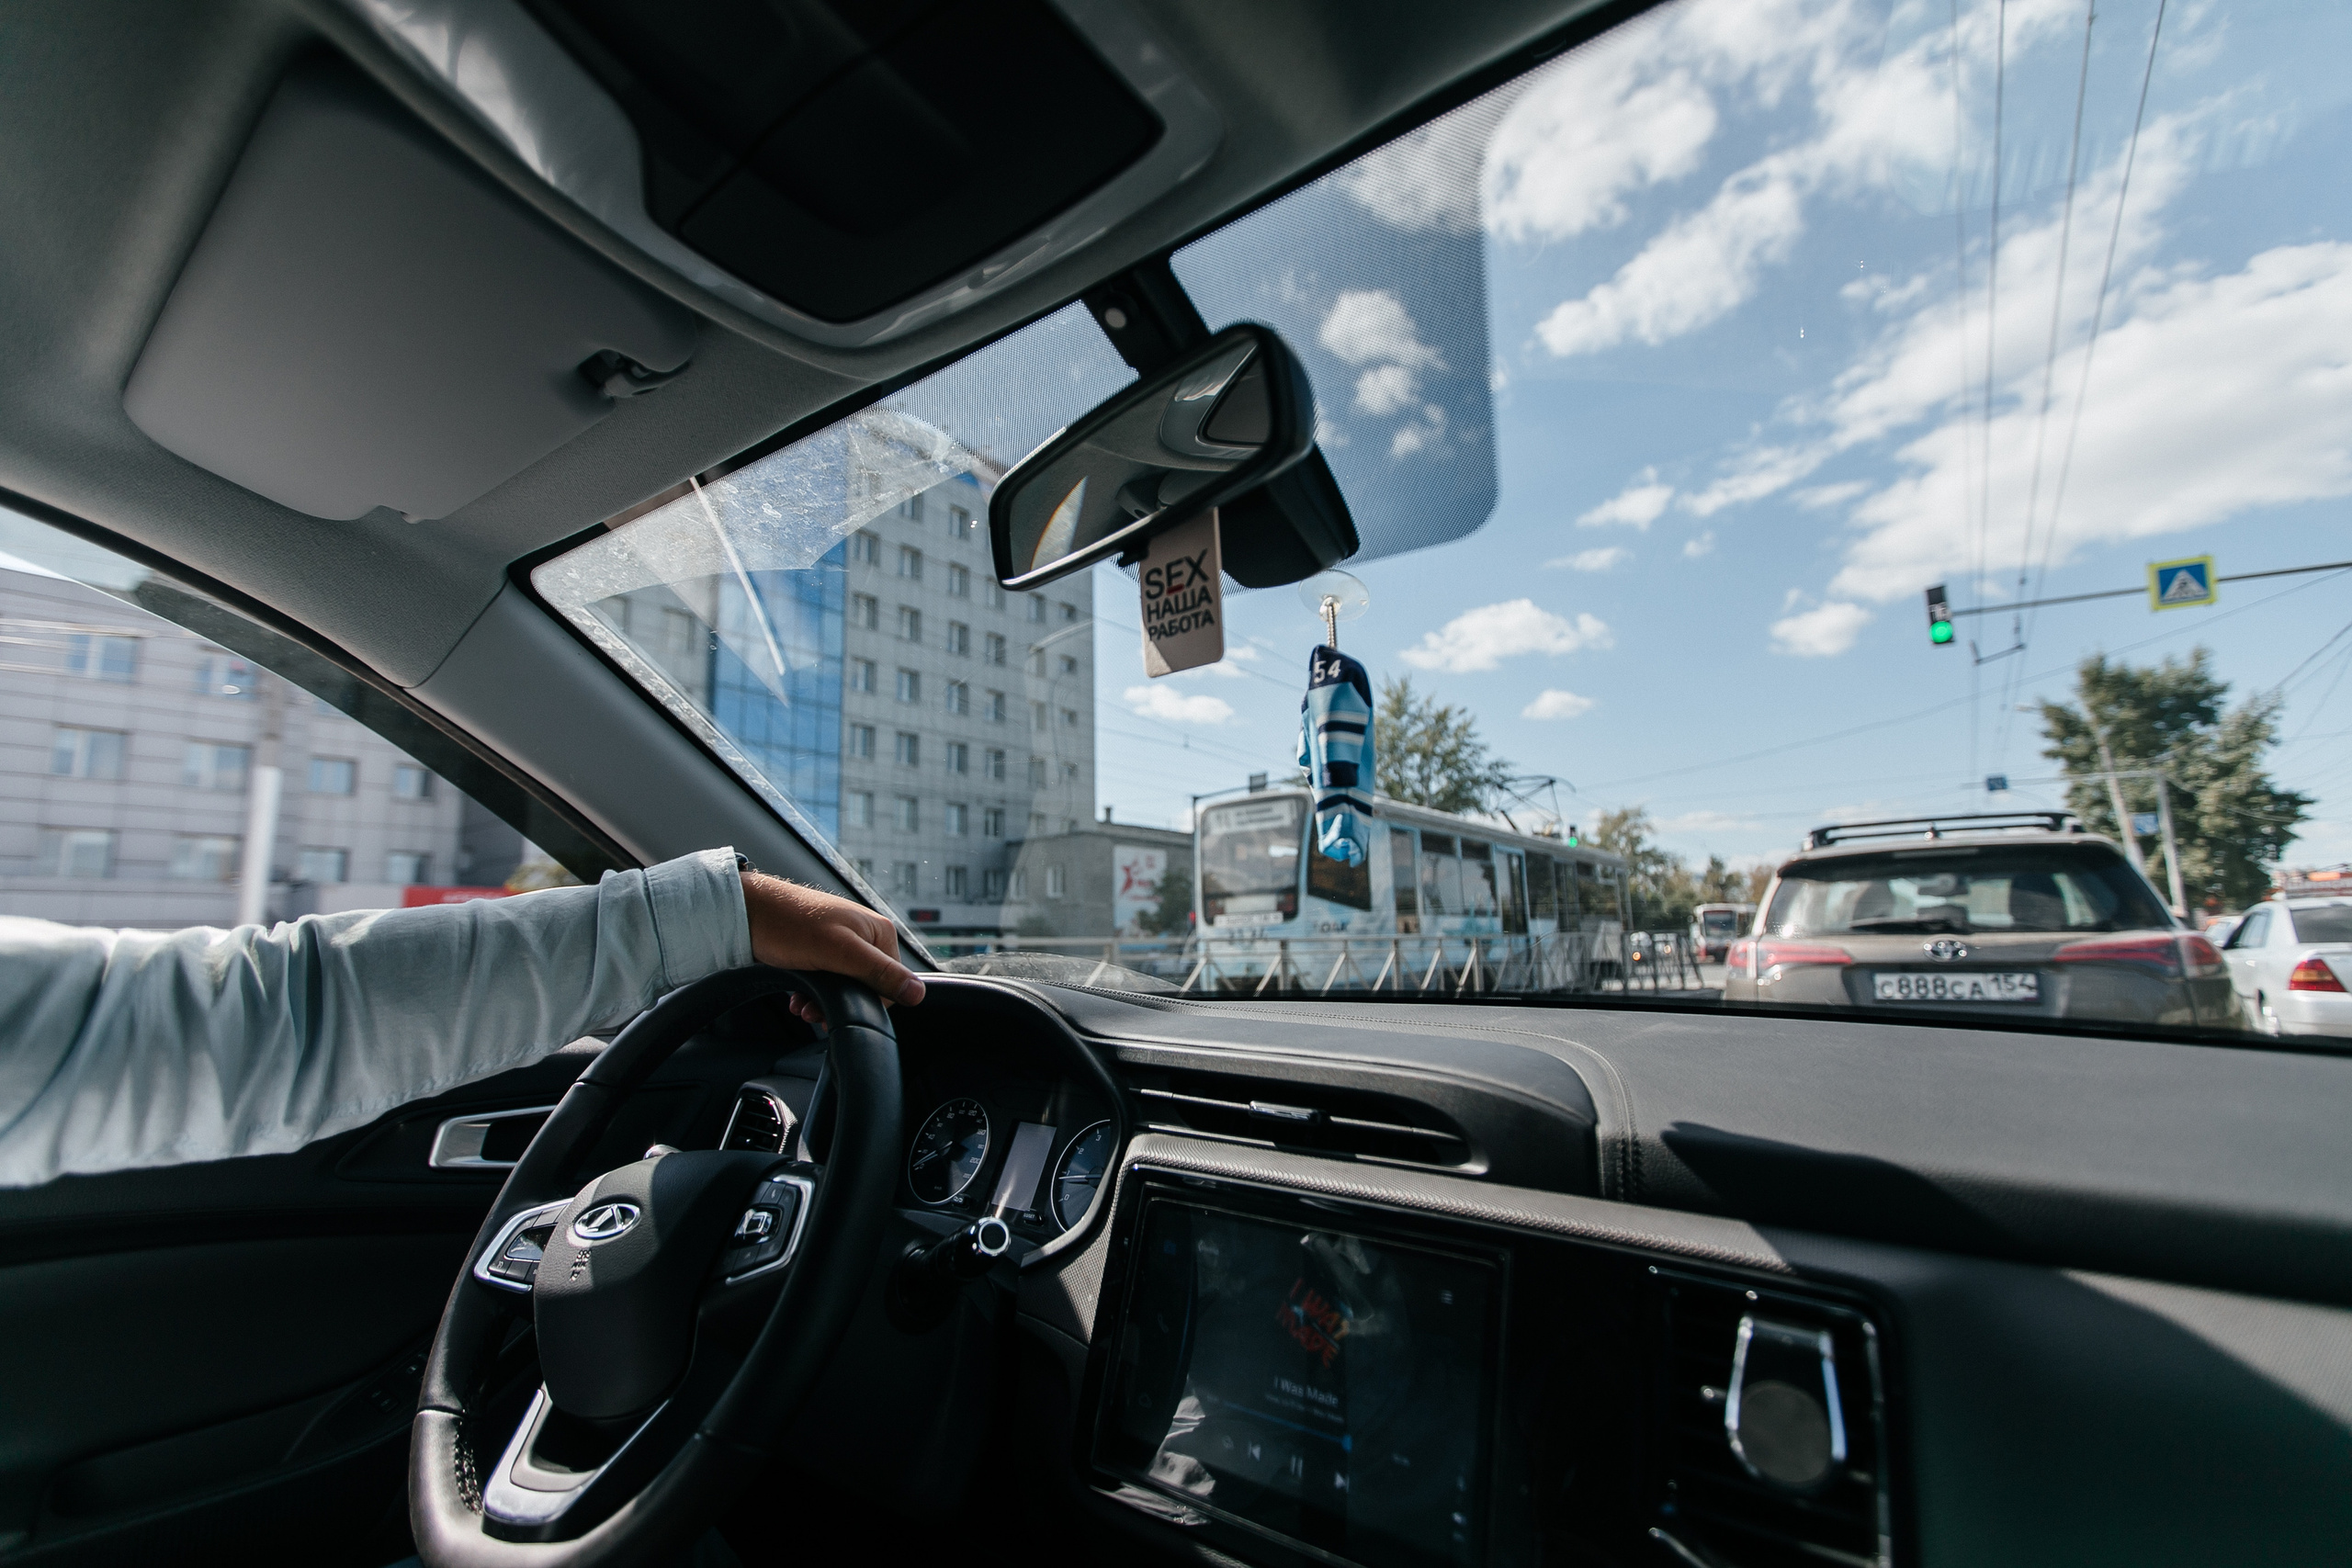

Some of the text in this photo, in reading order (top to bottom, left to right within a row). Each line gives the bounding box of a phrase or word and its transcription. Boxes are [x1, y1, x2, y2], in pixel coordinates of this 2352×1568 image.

[1145, 548, 1209, 600] SEX
[1147, 585, 1213, 623] НАША
[1148, 609, 1215, 641] РАБОТА
[1313, 660, 1341, 683] 54
[1280, 1378, 1305, 1397] Was
[1306, 1384, 1340, 1408] Made
